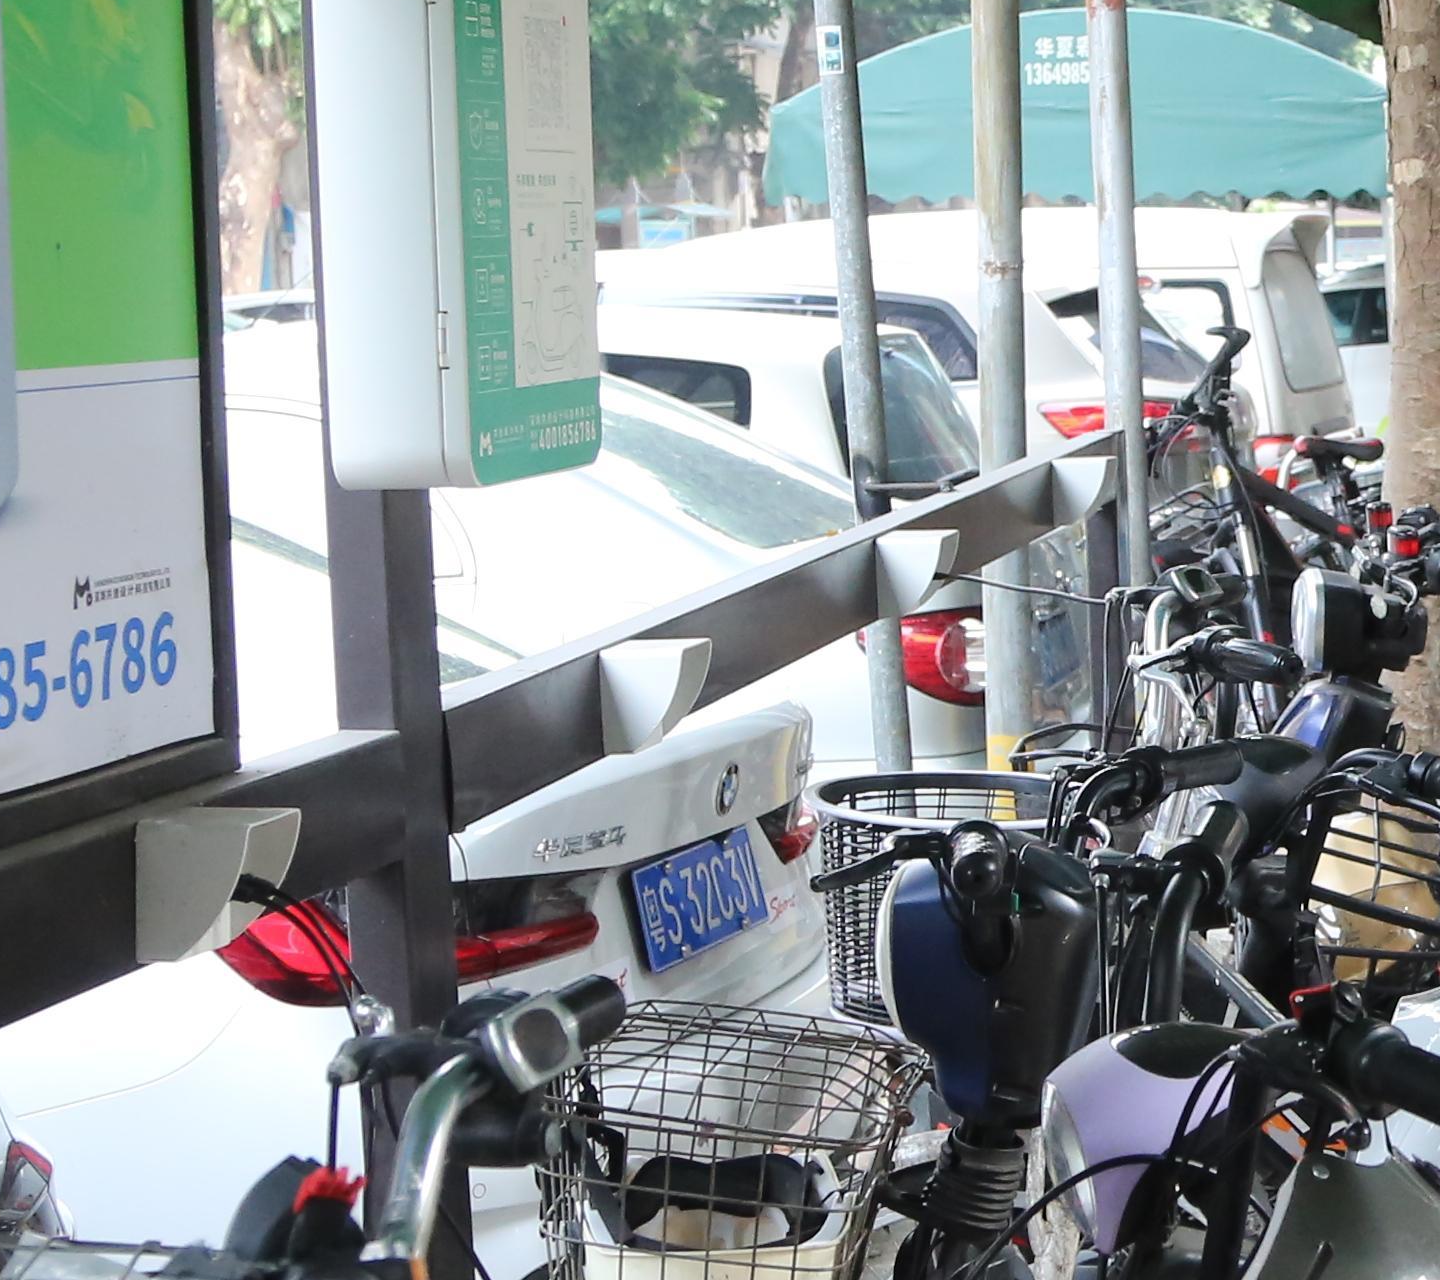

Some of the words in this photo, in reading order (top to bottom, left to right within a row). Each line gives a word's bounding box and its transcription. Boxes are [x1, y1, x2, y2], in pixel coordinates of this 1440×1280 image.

[1024, 62, 1090, 86] 1364985
[533, 825, 627, 863] 华晨宝马
